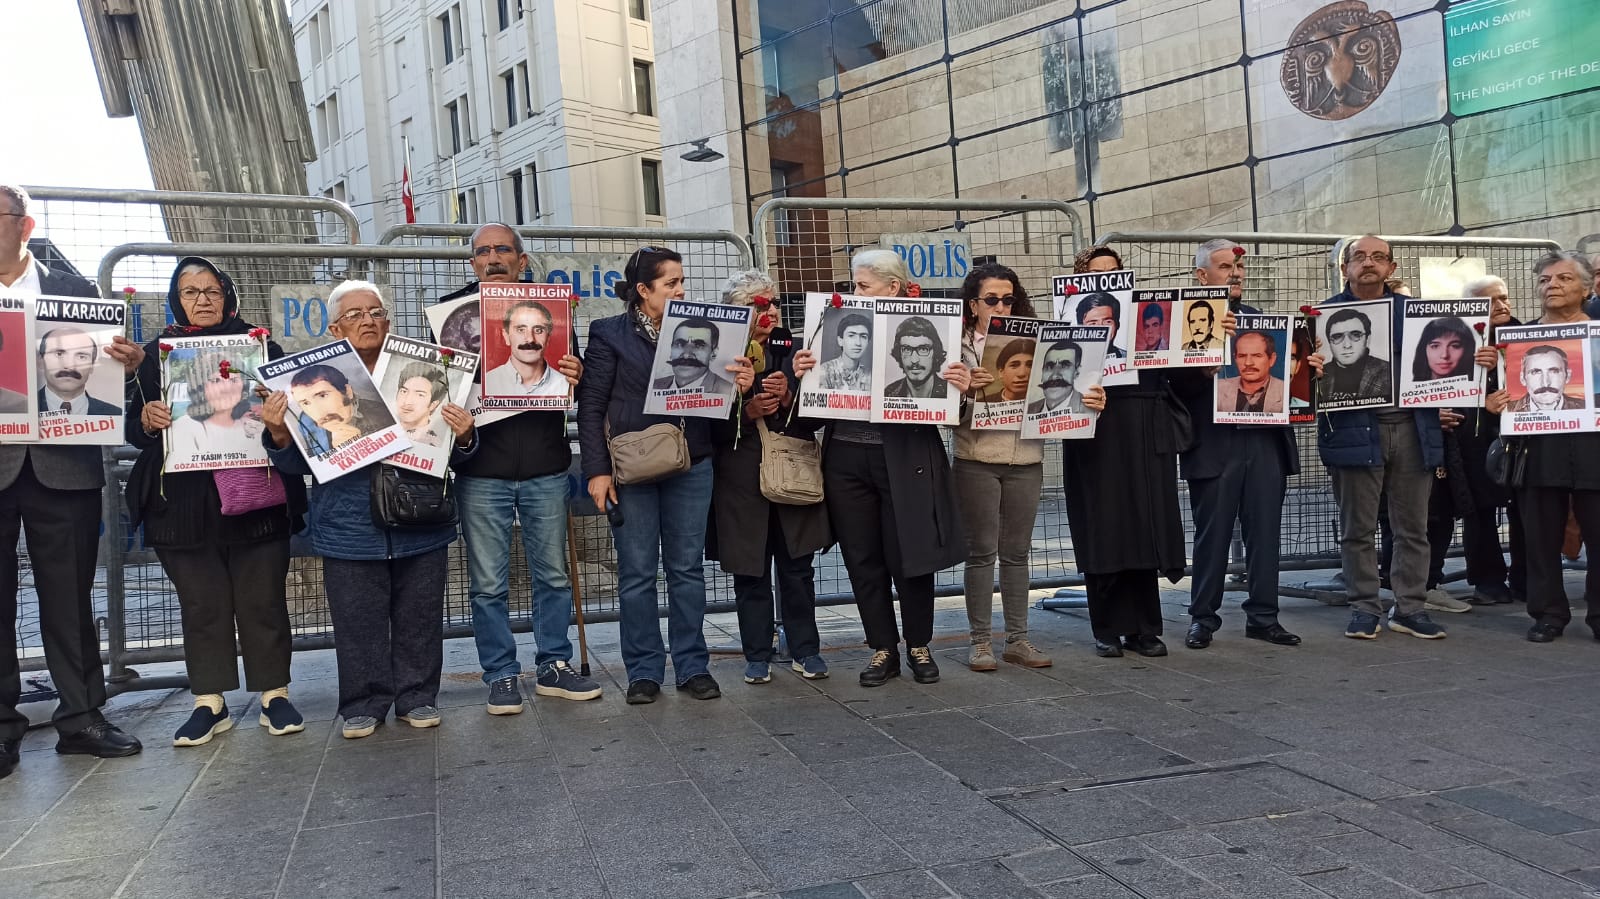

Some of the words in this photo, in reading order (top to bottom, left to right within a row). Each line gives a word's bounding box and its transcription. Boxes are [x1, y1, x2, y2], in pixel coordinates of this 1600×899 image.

[1450, 19, 1489, 37] İLHAN
[1492, 8, 1531, 26] SAYIN
[1504, 38, 1540, 55] GECE
[1454, 88, 1479, 102] THE
[1482, 78, 1525, 96] NIGHT
[1527, 73, 1545, 86] OF
[1549, 66, 1577, 81] THE
[1100, 272, 1133, 290] OCAK
[482, 287, 525, 297] KENAN
[528, 286, 570, 298] BİLGİN
[1139, 291, 1153, 300] EDİP
[1154, 291, 1172, 301] ÇELİK
[1183, 289, 1208, 298] İBRAHİM
[1209, 289, 1226, 298] ÇELİK
[825, 298, 858, 307] FHAT
[876, 301, 931, 314] HAYRETTİN
[933, 304, 960, 314] EREN
[1407, 303, 1451, 317] AYŞENUR
[1452, 301, 1488, 316] ŞİMŞEK
[62, 304, 123, 326] KARAKOÇ
[670, 304, 704, 317] NAZIM
[706, 306, 747, 321] GÜLMEZ
[1004, 319, 1040, 335] YETER
[1252, 316, 1287, 330] BİRLİK
[1042, 329, 1070, 340] NAZIM
[1072, 327, 1106, 340] GÜLMEZ
[1500, 330, 1558, 341] ABDULSELAM
[1560, 327, 1586, 339] ÇELİK
[176, 339, 224, 349] SEDİKA
[227, 338, 252, 346] DAL
[265, 362, 297, 377] CEMİL
[298, 343, 347, 366] KIRBAYIR
[386, 339, 434, 359] MURAT
[435, 349, 475, 370] YDIZ
[1401, 385, 1455, 397] GÖZALTINDA
[1403, 388, 1482, 405] KAYBEDİLDİ
[483, 398, 528, 407] GÖZALTINDA
[529, 398, 571, 407] KAYBEDİLDİ
[666, 398, 724, 411] KAYBEDİLDİ
[883, 402, 919, 410] GÖZALTINDA
[1318, 399, 1354, 409] NURETTİN
[1355, 396, 1387, 406] YEDİGÖL
[883, 409, 947, 421] KAYBEDİLDİ
[0, 422, 30, 435] EDİLDİ
[40, 418, 69, 427] LTINDA
[1039, 418, 1090, 435] KAYBEDİLDİ
[1513, 418, 1581, 432] KAYBEDİLDİ
[201, 453, 222, 461] KASIM
[329, 436, 374, 465] GÖZALTINDA
[337, 430, 398, 471] KAYBEDİLDİ
